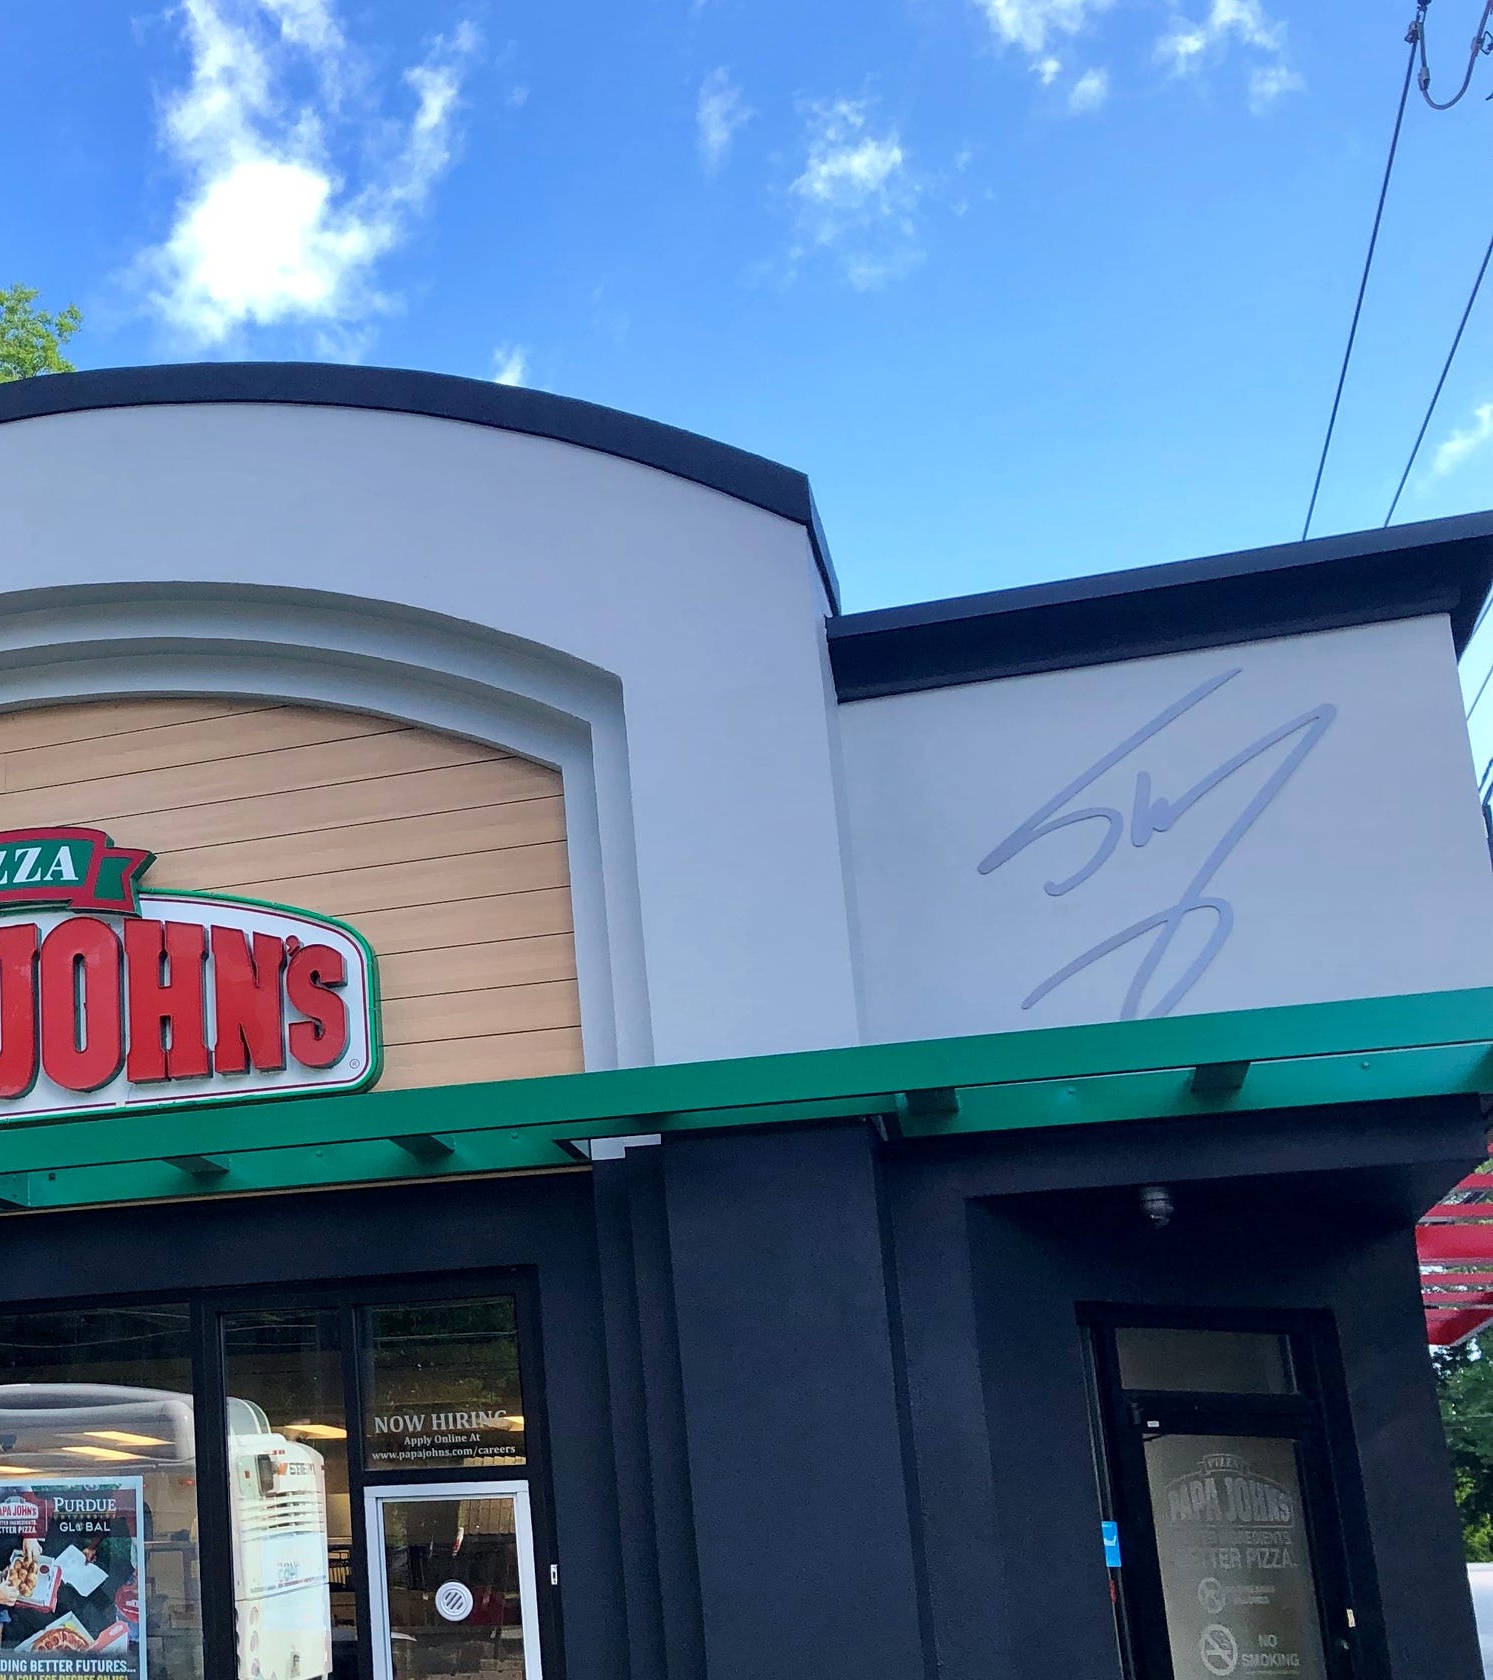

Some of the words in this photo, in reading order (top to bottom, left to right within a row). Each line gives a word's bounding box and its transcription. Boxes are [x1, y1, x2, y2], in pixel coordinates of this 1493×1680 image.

[374, 1414, 425, 1434] NOW
[403, 1436, 432, 1447] Apply
[434, 1434, 468, 1444] Online
[469, 1433, 481, 1442] At
[371, 1445, 516, 1461] www.papajohns.com/careers
[52, 1497, 117, 1512] PURDUE
[1258, 1634, 1277, 1648] NO
[30, 1659, 73, 1672] BETTER
[76, 1659, 136, 1673] FUTURES...
[1241, 1653, 1300, 1667] SMOKING
